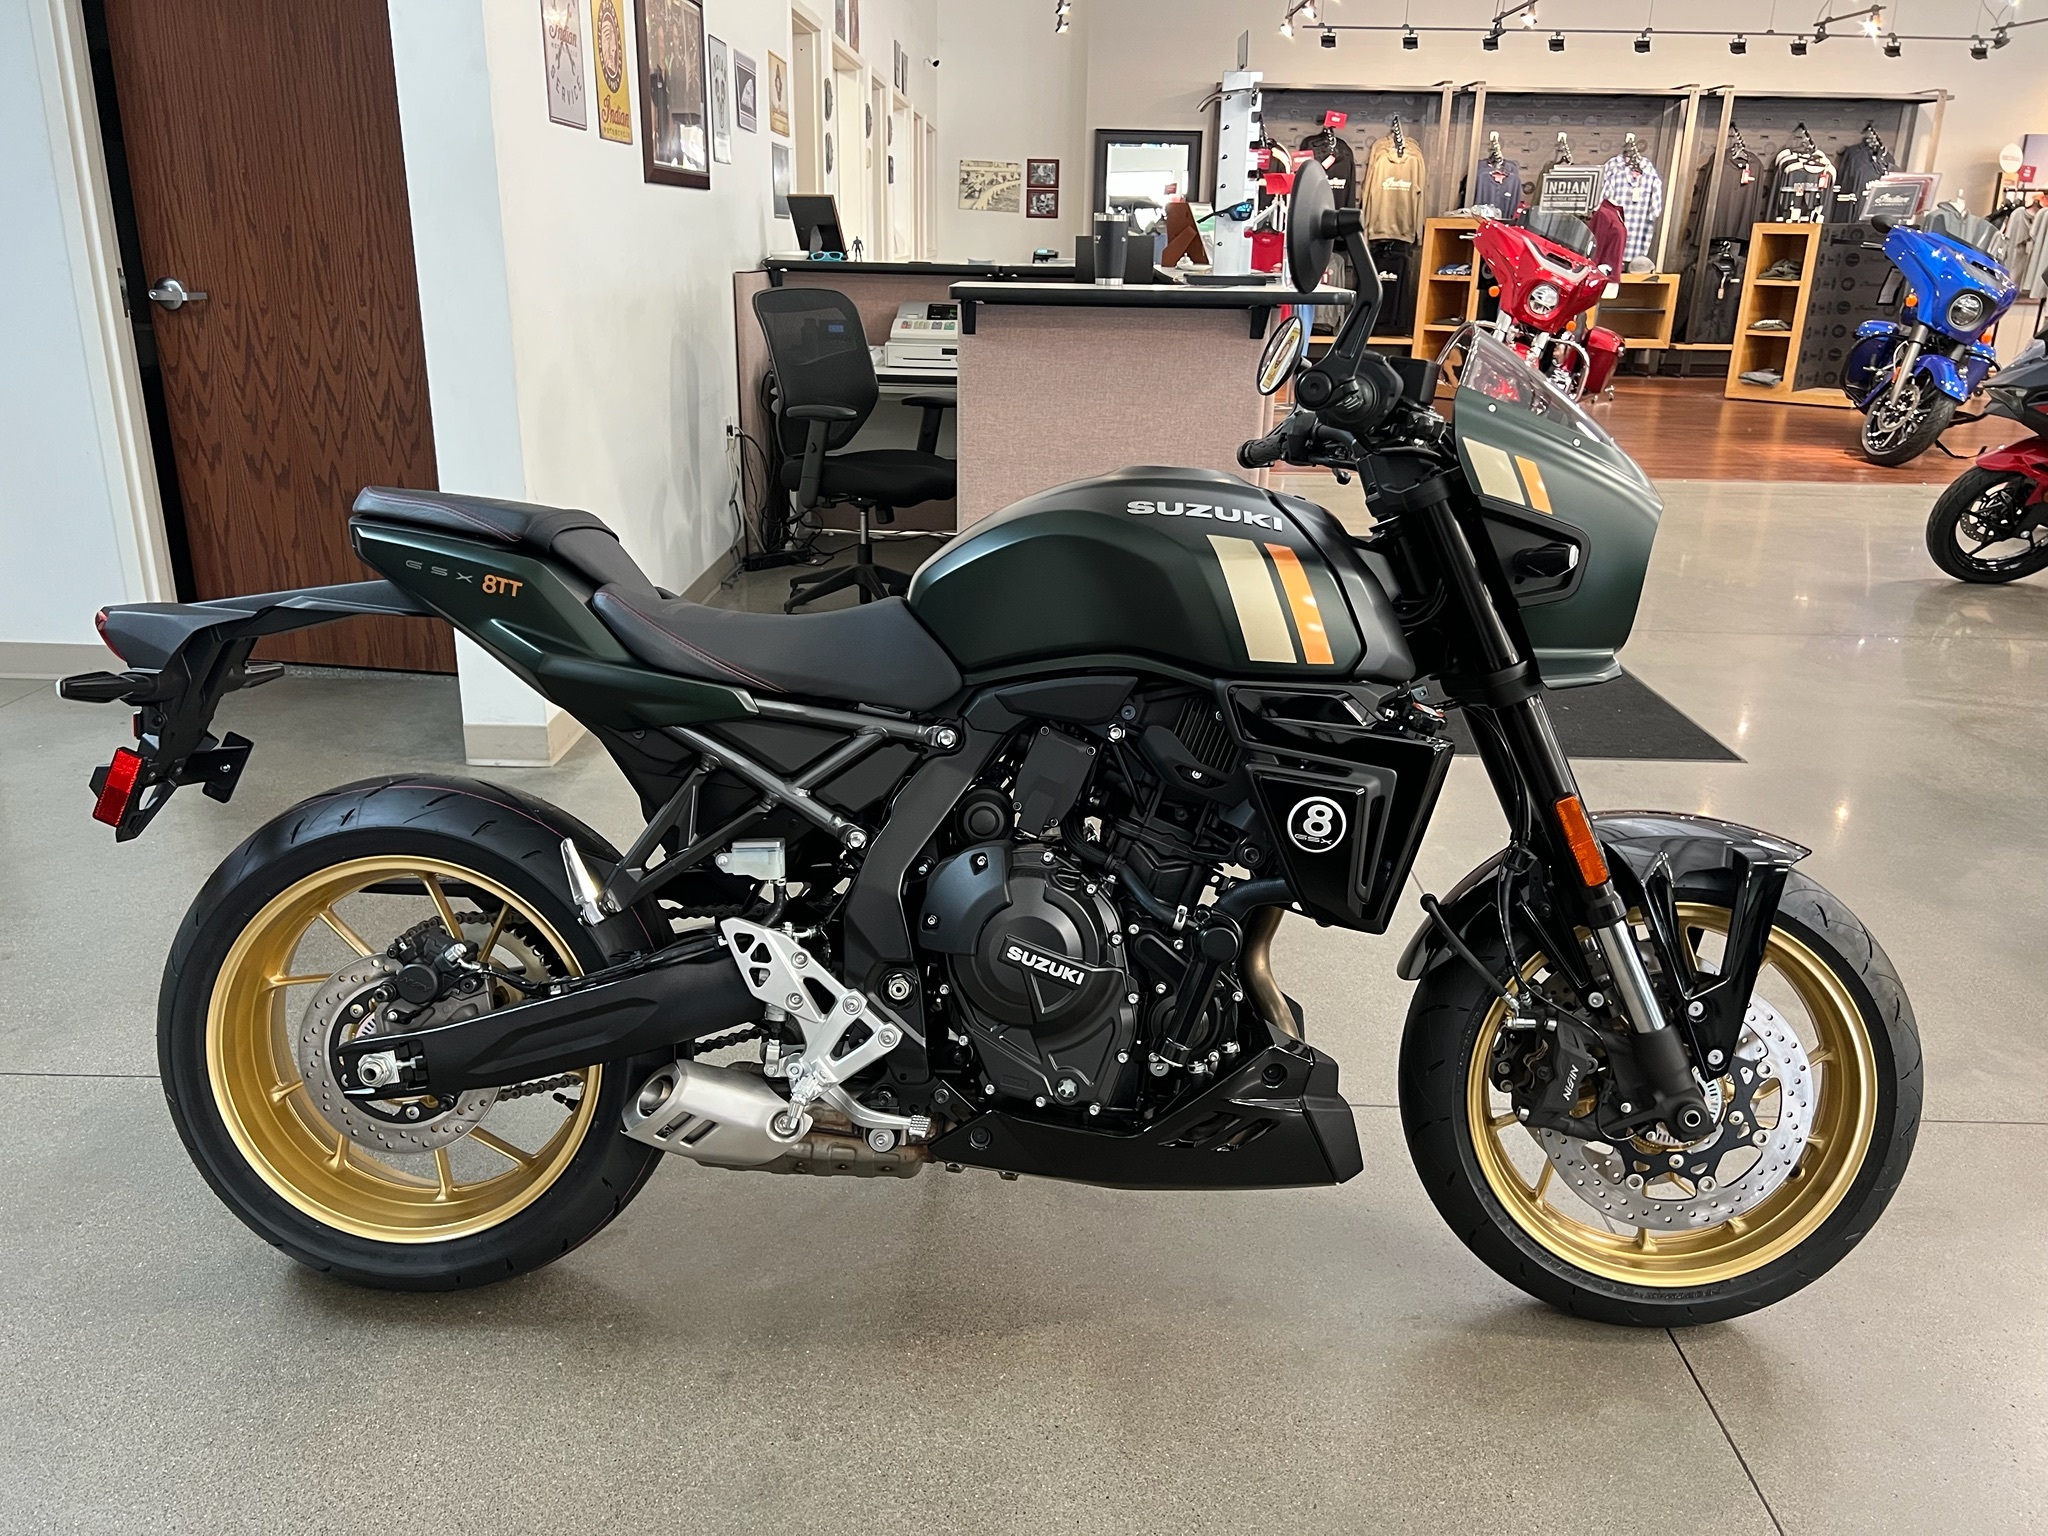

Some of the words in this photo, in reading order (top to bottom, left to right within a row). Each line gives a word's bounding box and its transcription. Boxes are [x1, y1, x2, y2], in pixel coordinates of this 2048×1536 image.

[549, 24, 577, 47] Indian
[550, 64, 582, 106] SERVICE
[601, 94, 629, 128] Indian
[1544, 181, 1589, 194] INDIAN
[1126, 500, 1283, 532] SUZUKI
[482, 574, 523, 597] 8TT
[1303, 804, 1333, 837] 8
[1294, 833, 1332, 845] GSX
[1006, 946, 1085, 985] SUZUKI
[1562, 1064, 1579, 1101] NISSIN
